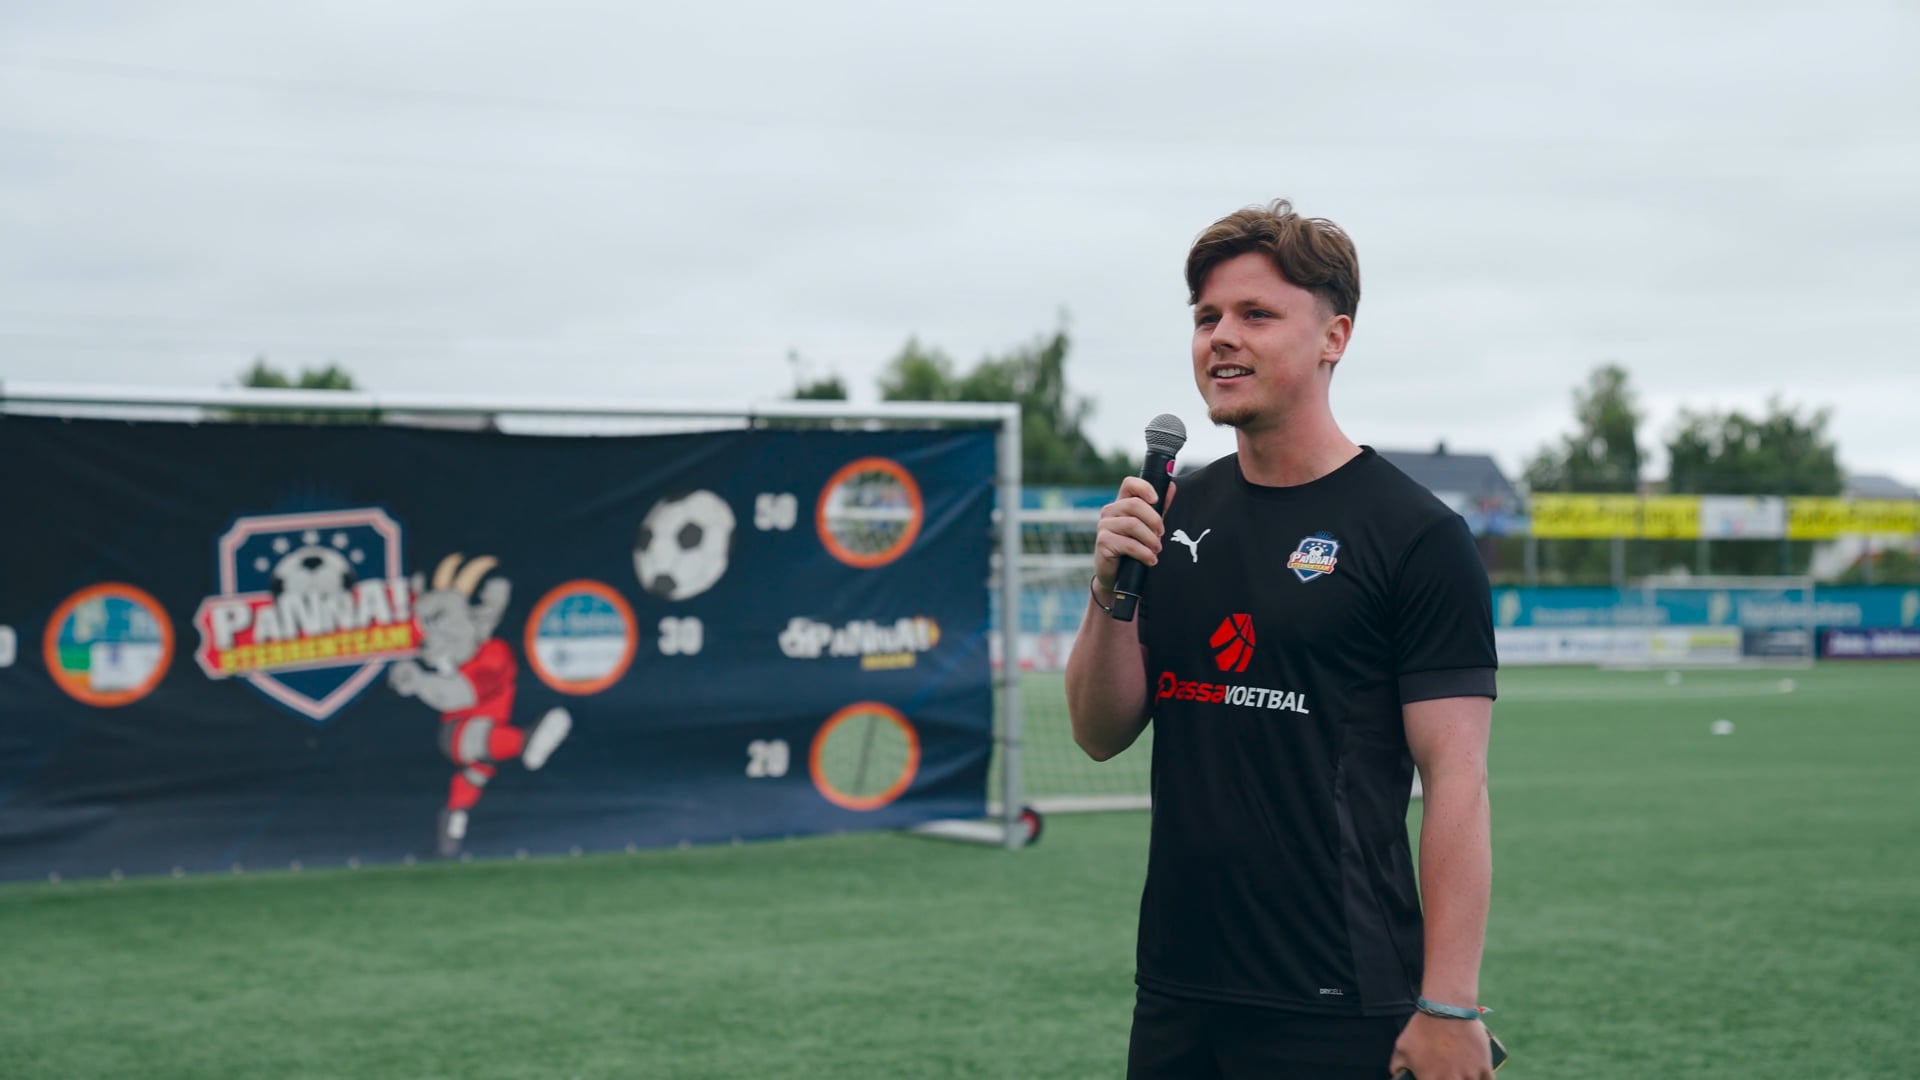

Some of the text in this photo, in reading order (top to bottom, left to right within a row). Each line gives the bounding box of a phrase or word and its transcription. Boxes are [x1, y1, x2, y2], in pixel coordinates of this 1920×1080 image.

[754, 492, 798, 531] 50
[658, 616, 703, 656] 30
[745, 739, 790, 778] 20
